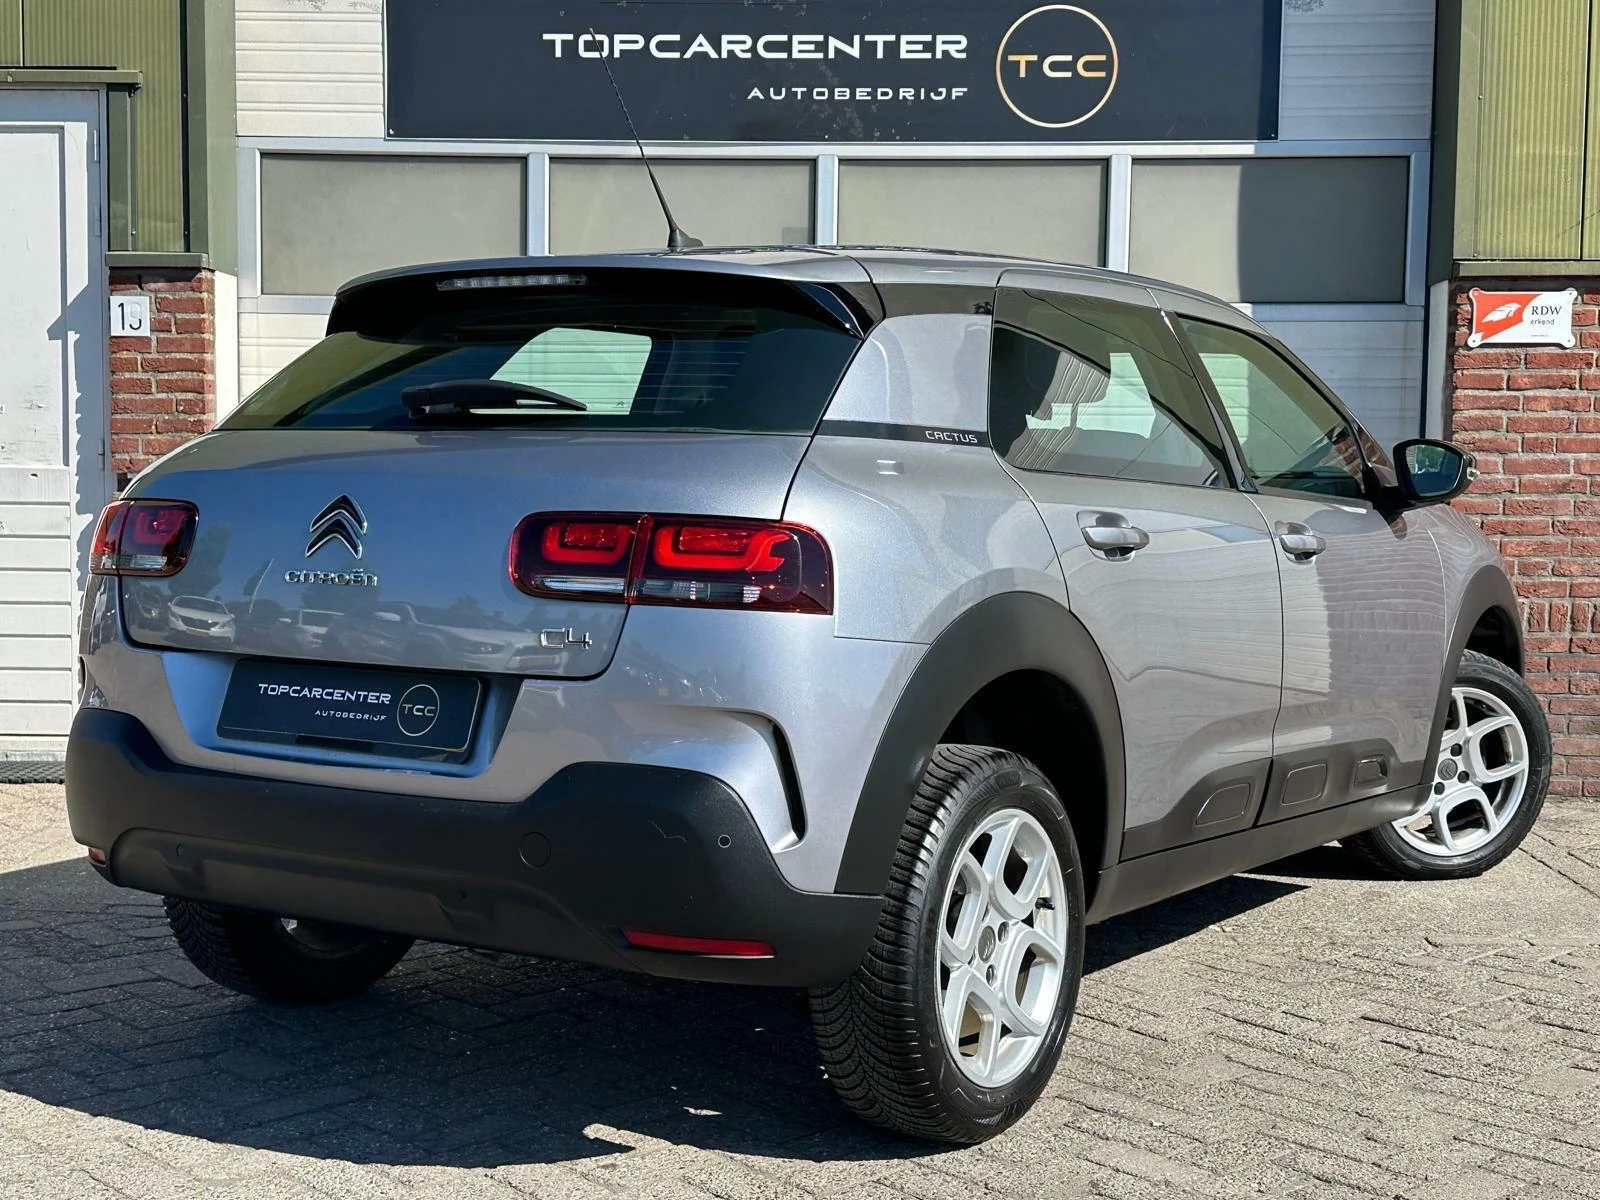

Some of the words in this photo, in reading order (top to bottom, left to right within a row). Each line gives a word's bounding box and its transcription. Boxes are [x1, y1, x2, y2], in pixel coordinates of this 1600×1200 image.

[543, 33, 968, 59] TOPCARCENTER
[1008, 54, 1107, 78] TCC
[747, 87, 968, 101] AUTOBEDRIJF
[1531, 305, 1562, 316] RDW
[925, 430, 978, 444] CACTUS
[540, 627, 593, 650] C4
[258, 683, 392, 705] TOPCARCENTER
[314, 709, 387, 721] AUTOBEDRIJF
[402, 703, 436, 717] TCC
